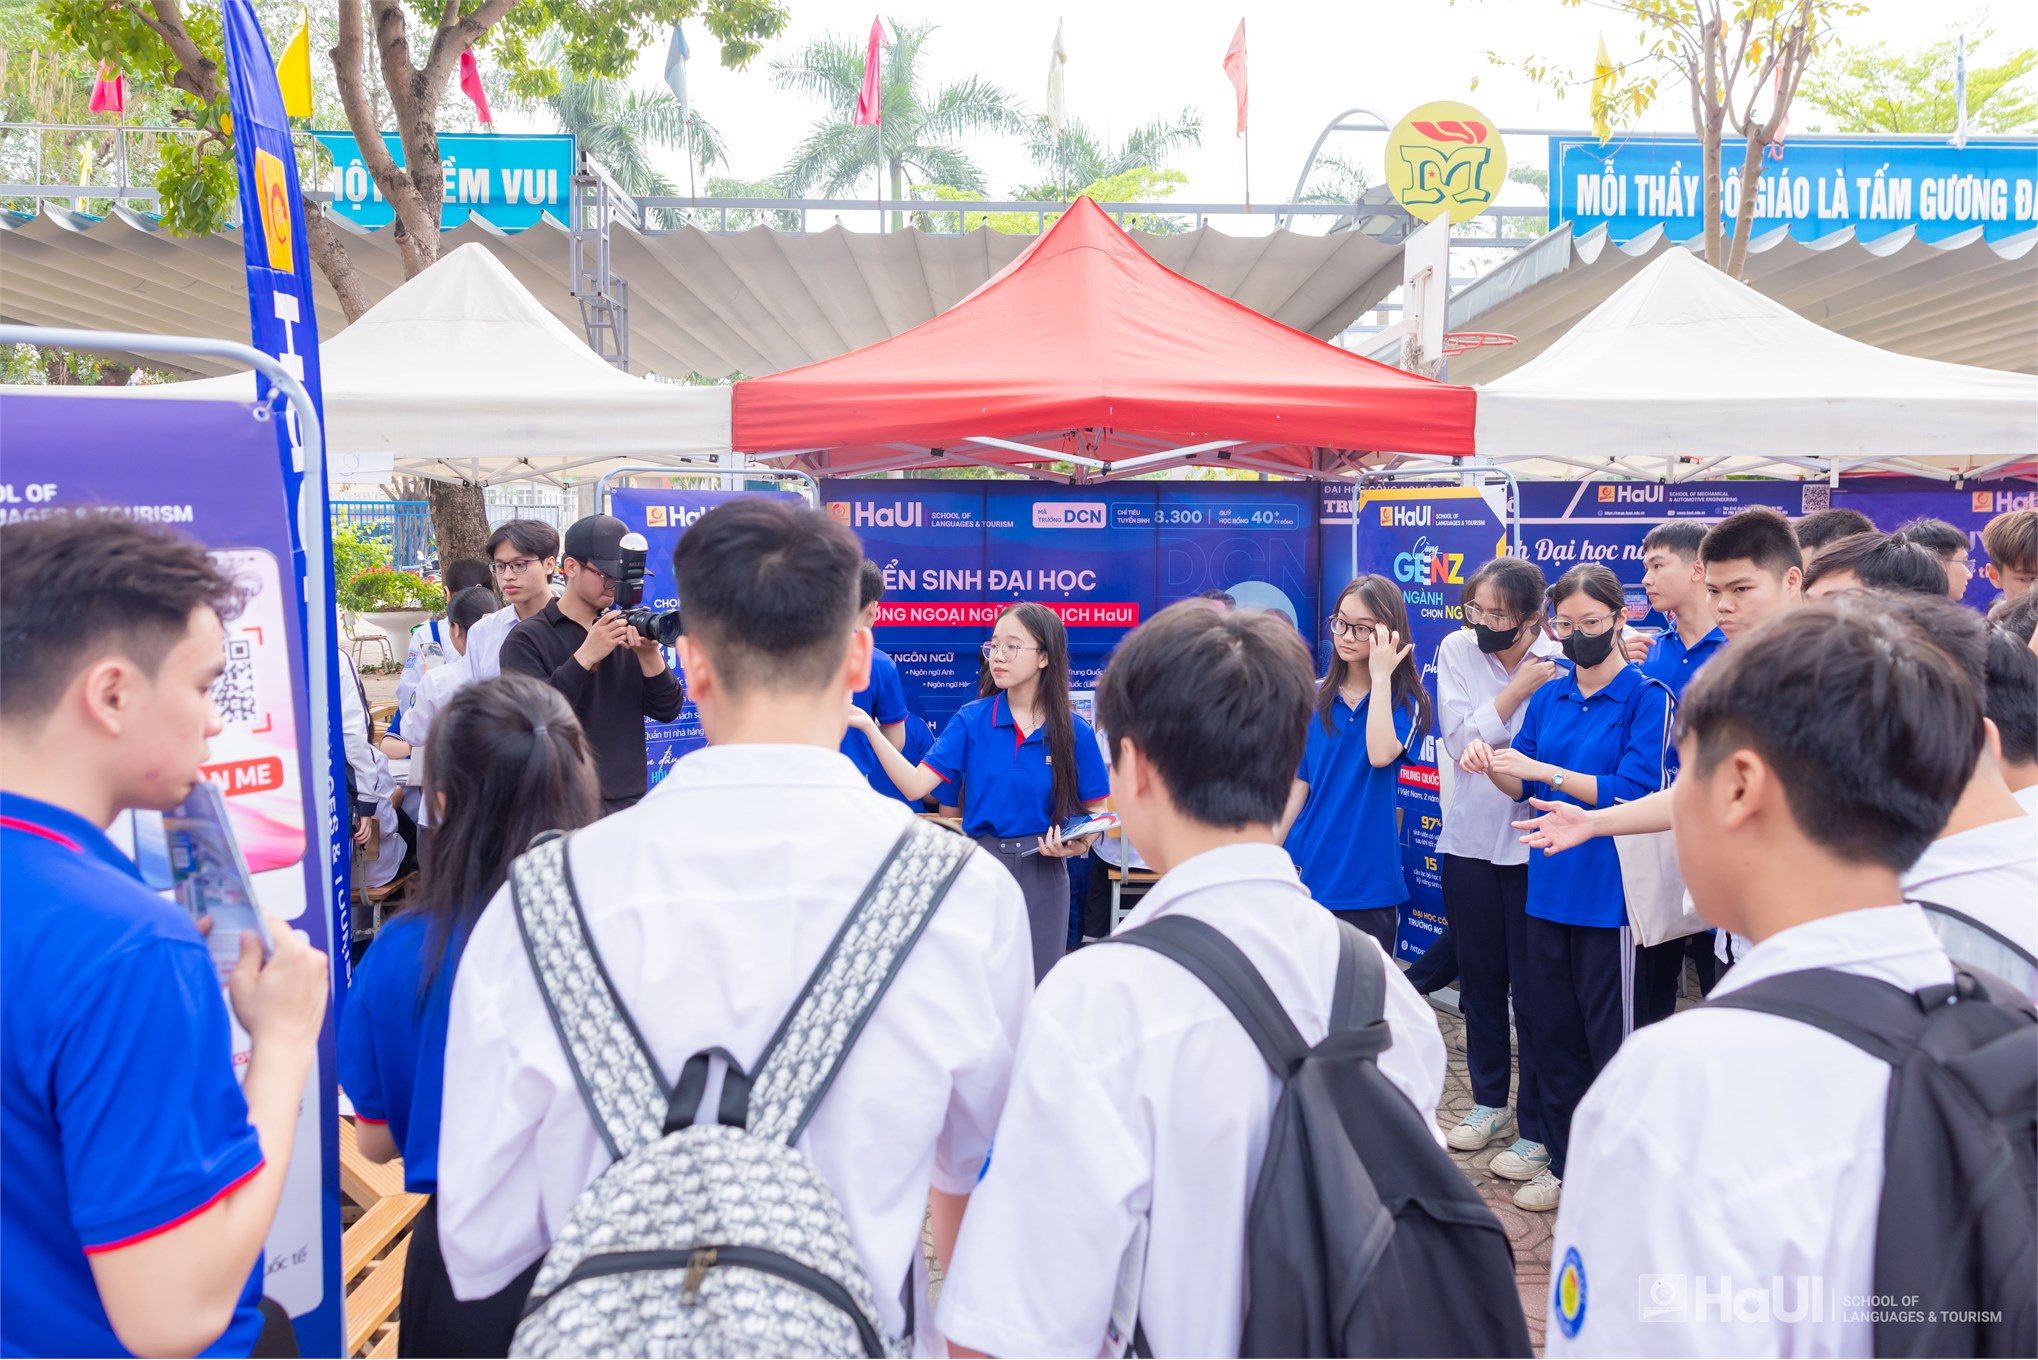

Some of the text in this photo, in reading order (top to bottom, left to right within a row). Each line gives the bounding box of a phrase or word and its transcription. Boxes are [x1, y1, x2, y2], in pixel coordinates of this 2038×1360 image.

[501, 168, 558, 205] VUI
[1576, 159, 1626, 217] MỖI
[1634, 160, 1700, 218] THẦY
[1818, 167, 1849, 220] LÀ
[1857, 162, 1912, 220] TẤM
[1920, 173, 2008, 221] GƯƠNG
[25, 483, 58, 503] OF
[1324, 485, 1341, 496] ĐẠI
[1617, 485, 1663, 502] HaUI
[855, 502, 922, 527] HaUI
[1064, 509, 1102, 524] DCN
[1154, 510, 1202, 524] 8.300
[1394, 505, 1431, 526] HaUI
[1535, 538, 1576, 567] Đại
[1580, 539, 1618, 565] học
[922, 569, 982, 590] SINH
[988, 569, 1032, 597] ĐẠI
[1039, 569, 1097, 597] HỌC
[1403, 588, 1443, 606] NGÀNH
[910, 608, 965, 626] NGOẠI
[1094, 608, 1132, 622] HaUI
[1421, 608, 1443, 620] CHỌN
[894, 652, 954, 662] NGÔN NGỮ
[672, 728, 686, 738] nhà
[687, 727, 704, 737] hàng
[235, 763, 272, 789] ME
[1422, 771, 1440, 786] QUỐC
[1423, 792, 1428, 800] 2
[1424, 855, 1438, 871] 15
[1412, 908, 1423, 919] ĐẠI
[1423, 911, 1437, 923] HỌC
